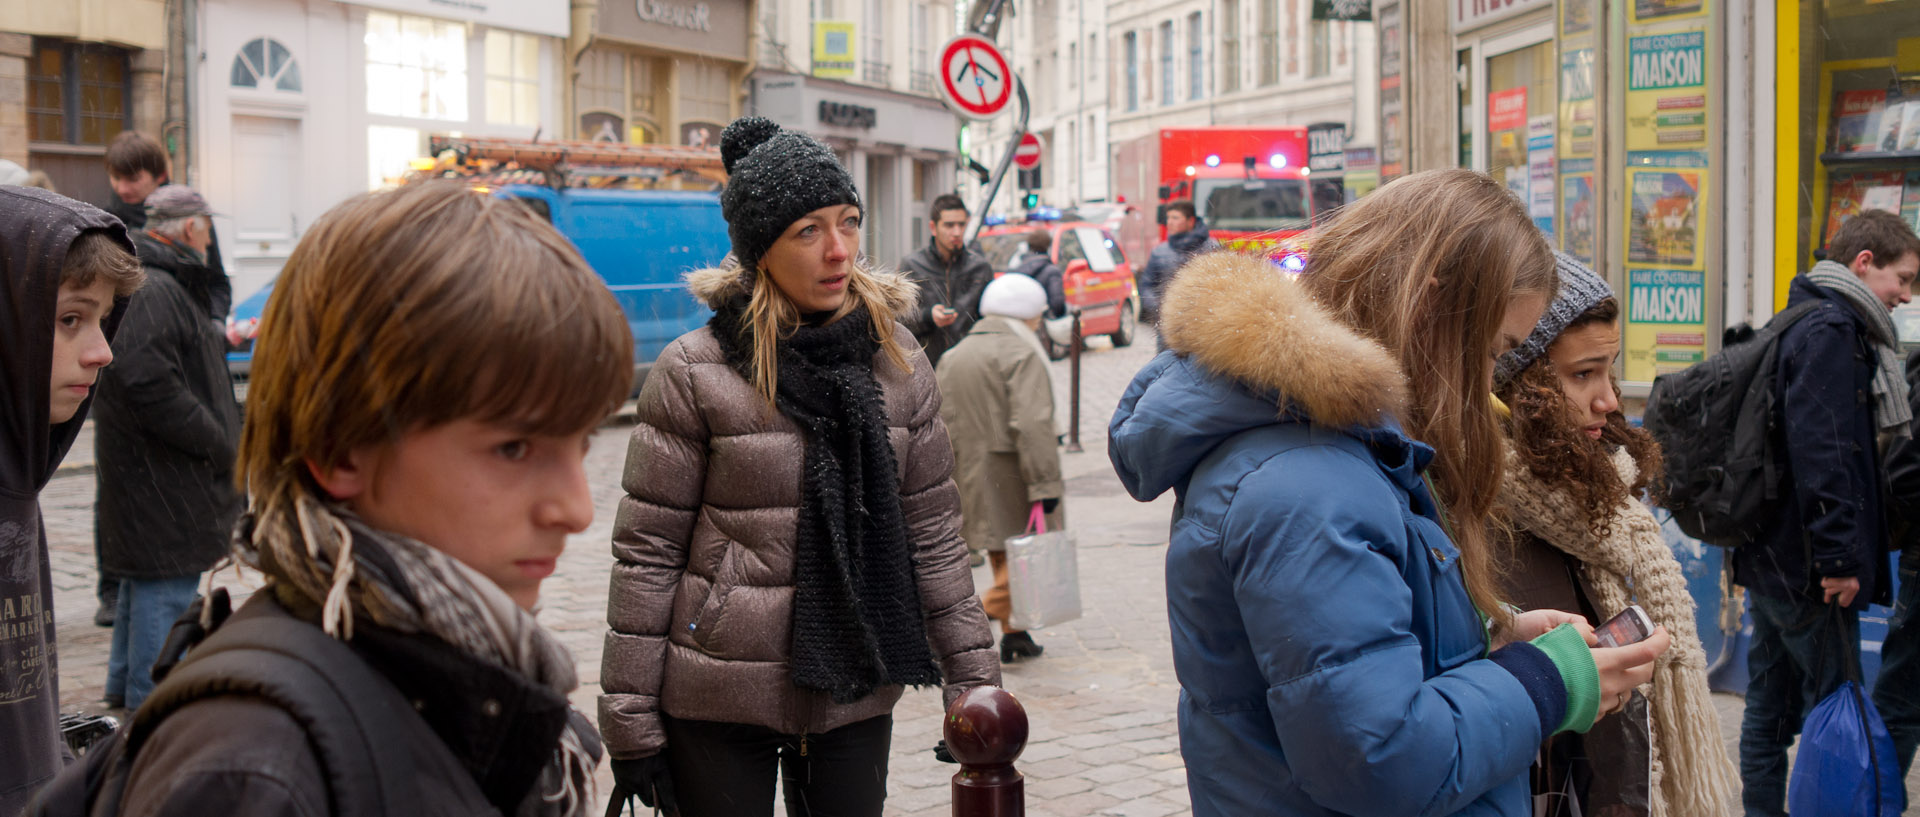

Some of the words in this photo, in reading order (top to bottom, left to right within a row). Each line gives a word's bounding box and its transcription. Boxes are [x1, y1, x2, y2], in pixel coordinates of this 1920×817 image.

[1632, 38, 1651, 50] FAIRE
[1632, 49, 1701, 88] MAISON
[1310, 129, 1345, 154] TIME
[1632, 271, 1652, 284] FAIRE
[1654, 271, 1702, 286] CONSTRUIRE
[1632, 286, 1702, 322] MAISON
